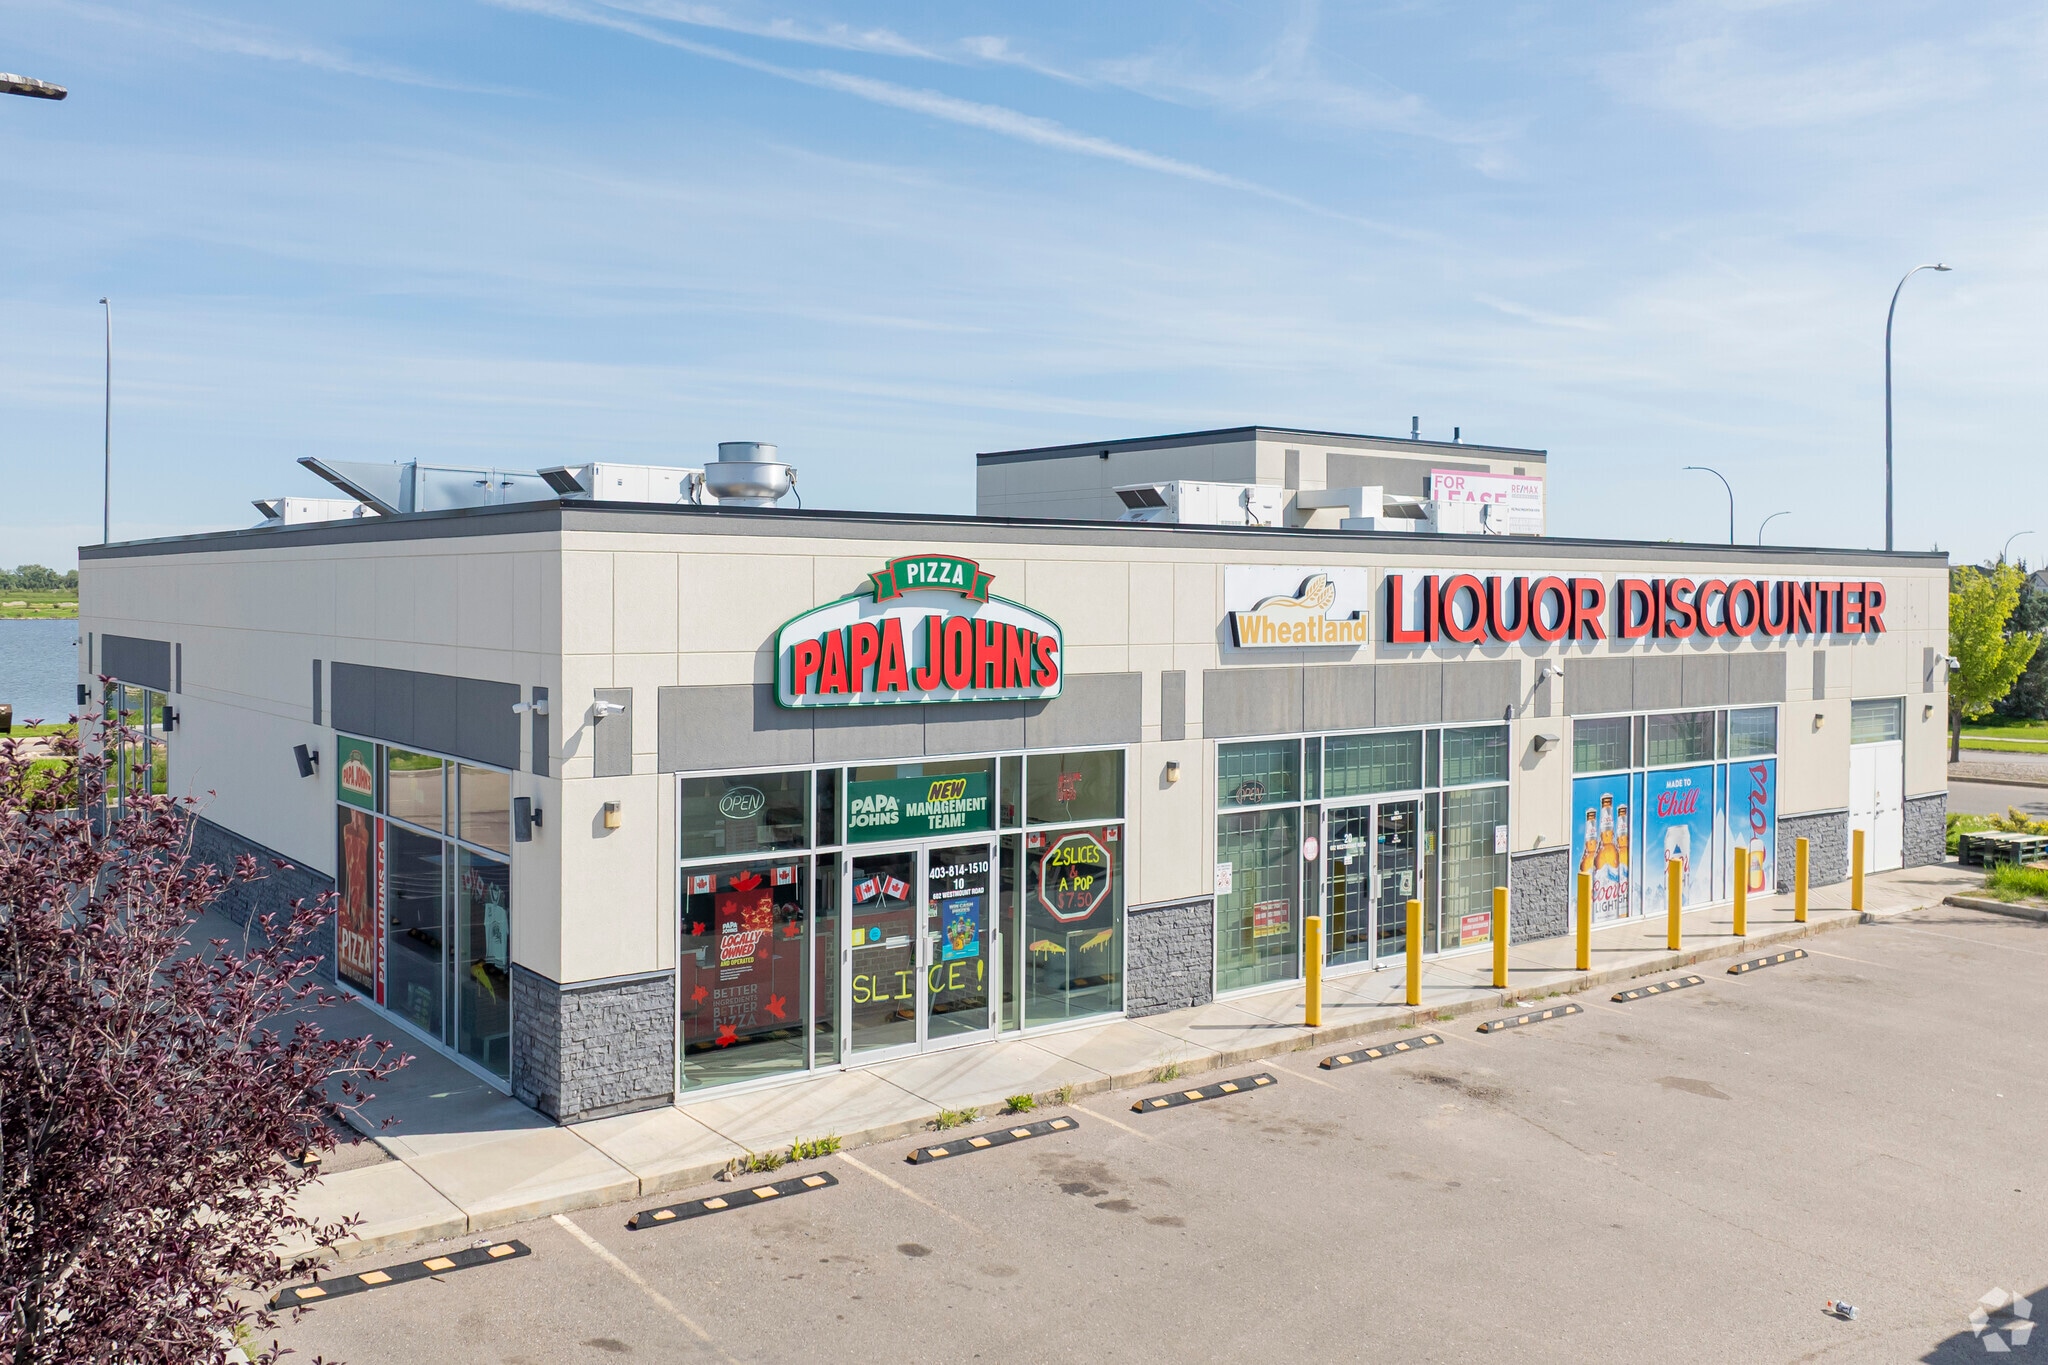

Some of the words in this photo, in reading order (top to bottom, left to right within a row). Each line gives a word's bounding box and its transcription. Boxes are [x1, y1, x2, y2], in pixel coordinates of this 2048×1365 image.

[1434, 475, 1465, 490] FOR
[1511, 484, 1539, 494] RE/MAX
[907, 562, 964, 586] PIZZA
[1386, 574, 1607, 645] LIQUOR
[1617, 577, 1887, 639] DISCOUNTER
[1238, 614, 1367, 644] Wheatland
[790, 617, 910, 696] PAPA
[911, 615, 1060, 692] JOHN'S
[928, 778, 967, 802] NEW
[1666, 779, 1683, 788] MADE
[1684, 778, 1692, 787] TO
[1239, 787, 1263, 801] OPEN
[1658, 787, 1700, 818] Chill
[722, 794, 761, 812] OPEN
[851, 794, 899, 815] PAPA
[906, 797, 987, 817] MANAGEMENT
[849, 812, 899, 828] JOHNS
[928, 813, 966, 830] TEAM!
[1344, 833, 1353, 844] 20
[929, 860, 989, 879] 403-814-1510
[953, 878, 965, 890] 10
[1059, 877, 1068, 892] A
[1073, 875, 1094, 891] POP
[1592, 880, 1619, 902] Coor
[933, 892, 942, 900] 602
[942, 889, 971, 899] WESTMOUNT
[971, 887, 985, 895] ROAD
[1057, 892, 1093, 909] $7.50
[1595, 898, 1618, 913] LIGHT
[722, 922, 738, 930] PAPA
[720, 929, 763, 949] LOCALLY
[341, 926, 372, 974] PIZZA
[720, 943, 756, 961] OWNED
[720, 959, 731, 967] AND
[731, 957, 755, 966] OPERATED
[713, 983, 758, 999] BETTER
[713, 994, 758, 1007] INGREDIENTS
[713, 1001, 758, 1018] BETTER
[713, 1013, 757, 1031] PIZZA
